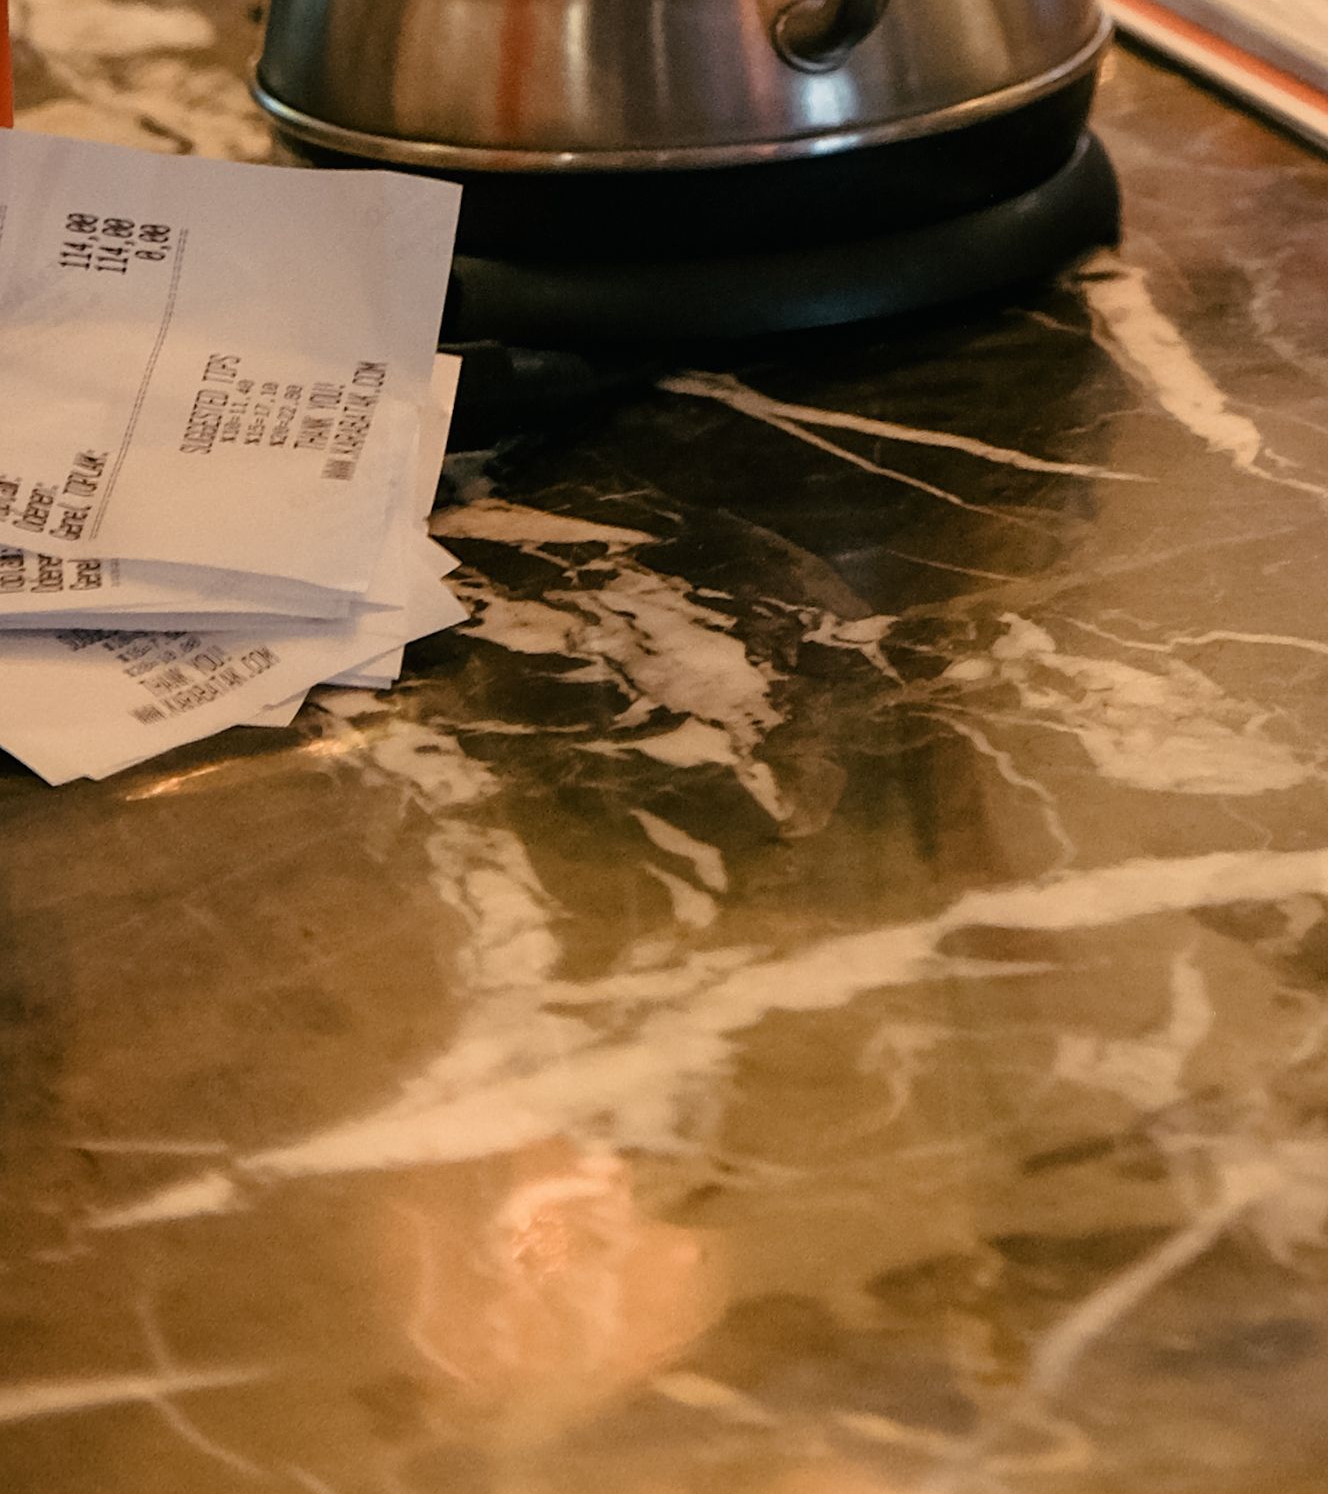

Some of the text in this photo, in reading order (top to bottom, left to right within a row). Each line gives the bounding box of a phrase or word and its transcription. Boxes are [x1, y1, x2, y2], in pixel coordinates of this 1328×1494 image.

[58, 213, 99, 270] 114,00
[96, 218, 136, 275] 114,00
[134, 223, 172, 261] 0,00
[179, 353, 242, 454] SUGGESTED TIPS
[292, 415, 335, 451] THANK
